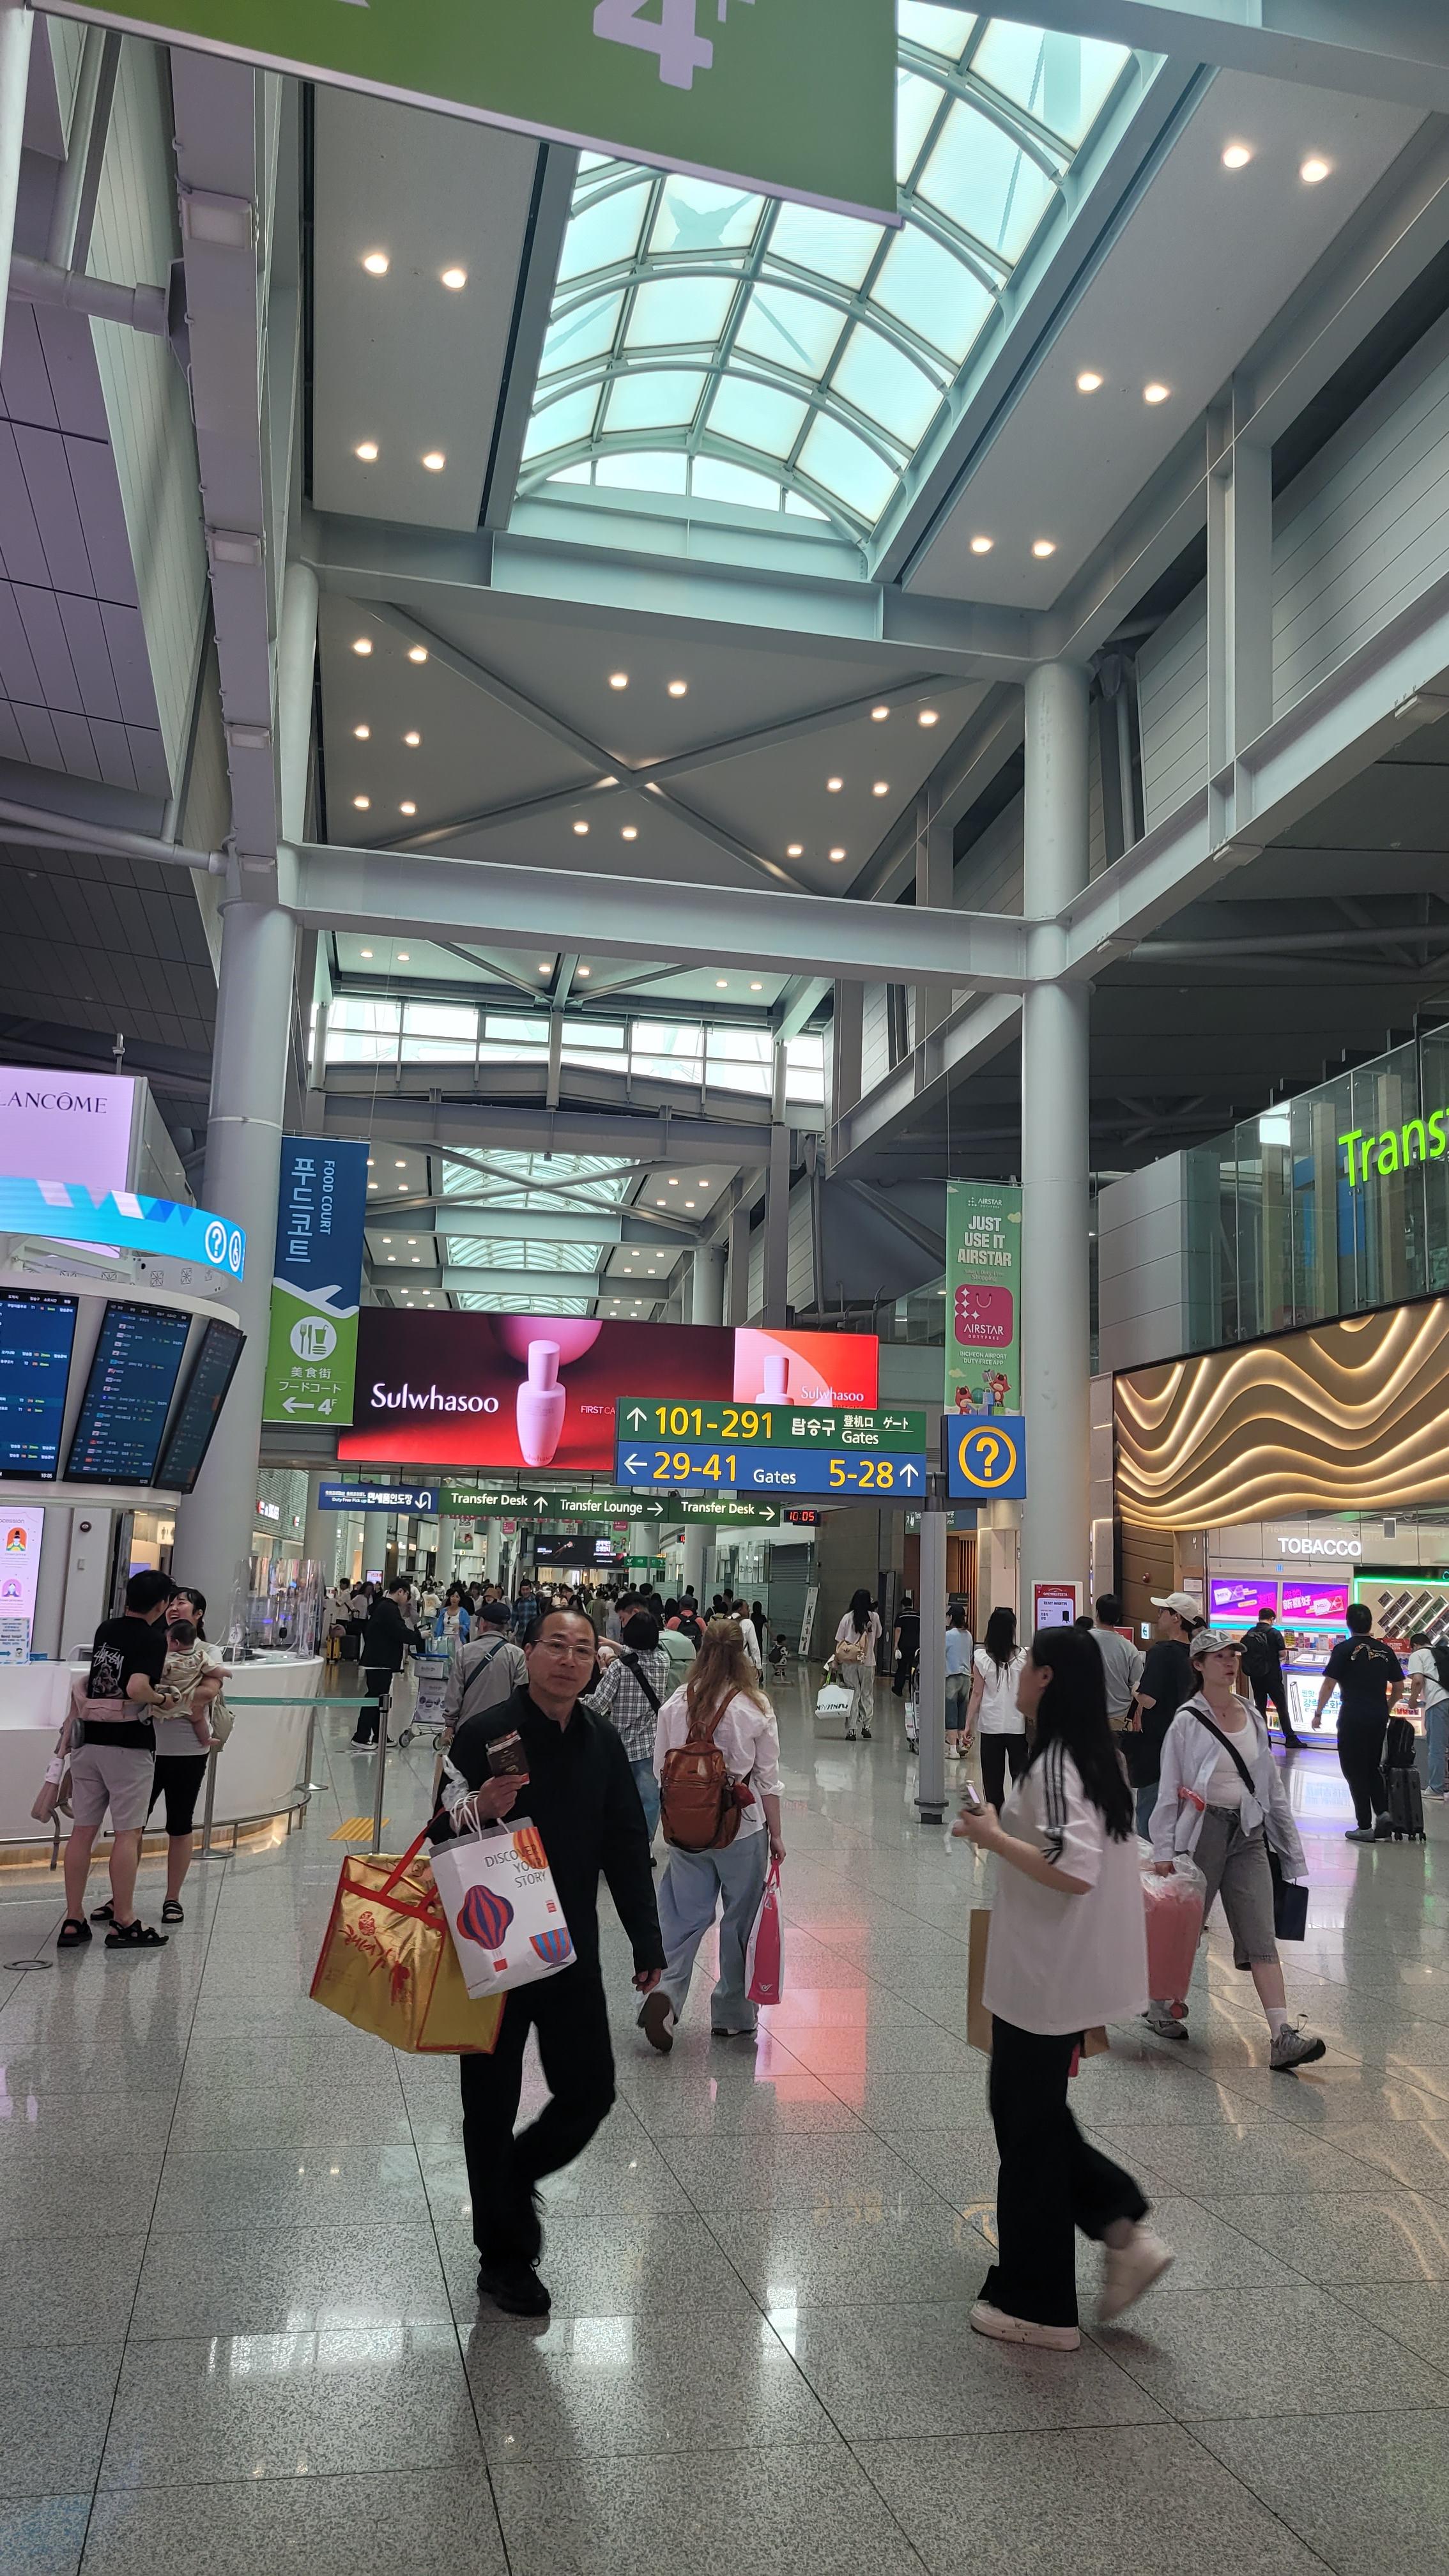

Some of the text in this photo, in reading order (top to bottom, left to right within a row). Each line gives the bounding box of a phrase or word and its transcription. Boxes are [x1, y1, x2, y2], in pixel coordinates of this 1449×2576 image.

[1338, 1108, 1449, 1188] Trans
[319, 1160, 335, 1235] FOOD COURT
[977, 1197, 1002, 1206] AIRSTAR
[285, 1157, 317, 1263] 푸드코트
[968, 1215, 1002, 1232] JUST
[963, 1231, 1006, 1249] USE IT
[957, 1248, 1012, 1267] AIRSTAR
[963, 1323, 1004, 1335] AIRSTAR
[291, 1366, 332, 1379] 美食街
[279, 1381, 342, 1394] フードコート
[801, 1385, 864, 1402] Sulwhasoo
[318, 1398, 338, 1415] 4F
[370, 1383, 500, 1413] Sulwhasoo
[581, 1405, 604, 1414] FIRST
[655, 1406, 772, 1439] 101-291
[792, 1417, 836, 1437] 탑승구
[843, 1414, 873, 1429] 登机口
[883, 1416, 908, 1430] ゲート
[841, 1430, 879, 1445] Gates
[652, 1451, 737, 1482] 29-41
[829, 1459, 894, 1489] 5-28
[753, 1469, 797, 1485] Gates
[367, 1492, 413, 1506] 면세품인도장
[450, 1492, 528, 1506] Transfer Desk
[560, 1499, 643, 1515] Transfer Lounge
[681, 1501, 755, 1515] Transfer Desk
[789, 1510, 815, 1522] 10:05
[1277, 1537, 1362, 1557] TOBACCO
[484, 1844, 537, 1867] DISCOVER
[514, 1871, 546, 1889] STORY
